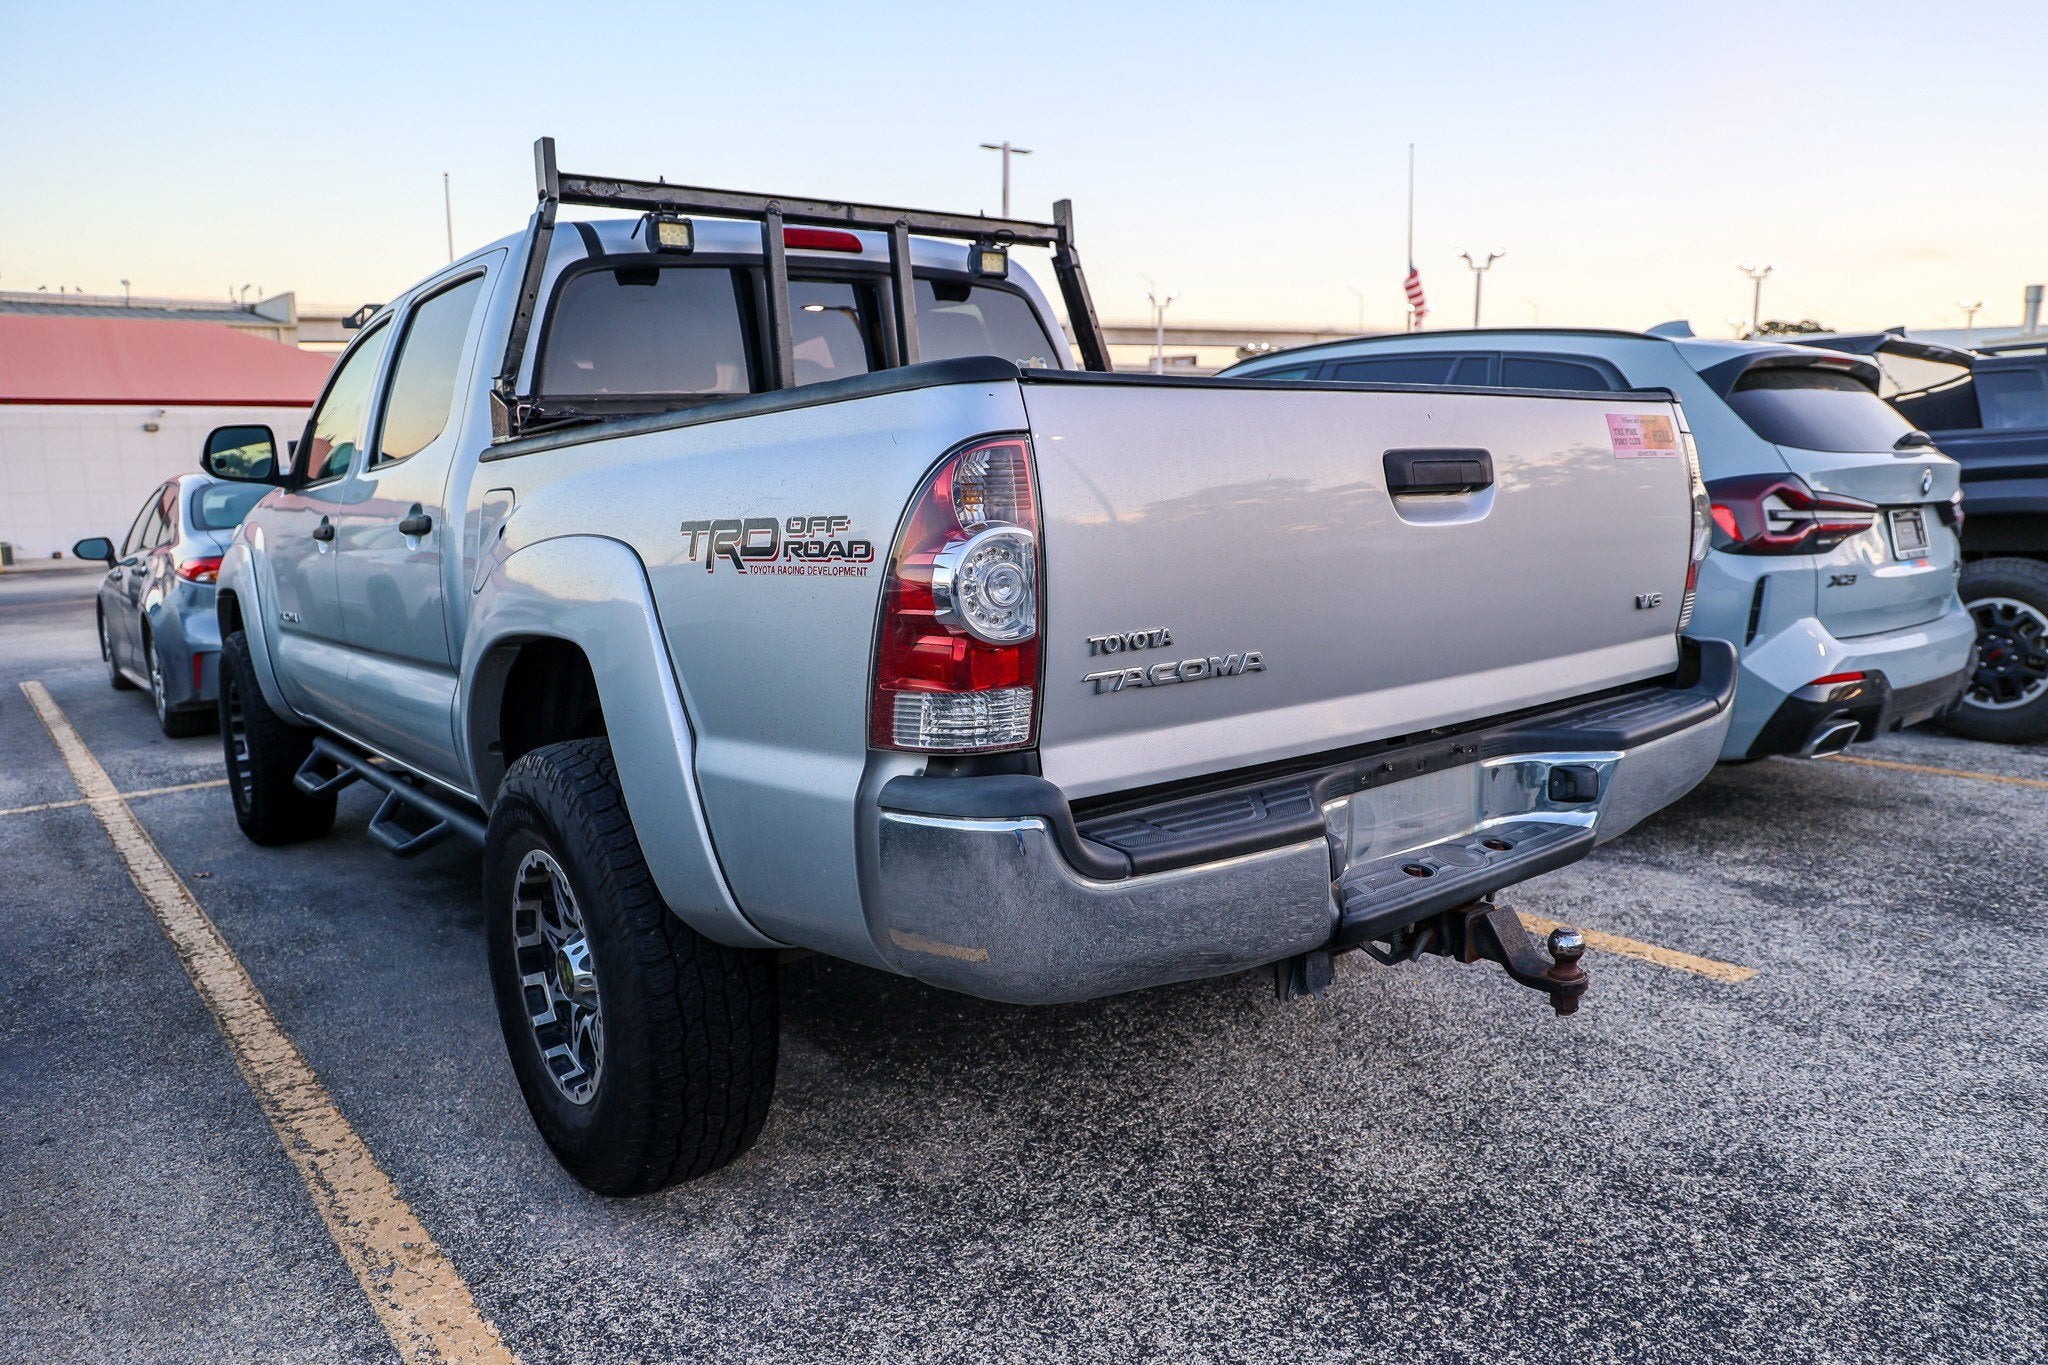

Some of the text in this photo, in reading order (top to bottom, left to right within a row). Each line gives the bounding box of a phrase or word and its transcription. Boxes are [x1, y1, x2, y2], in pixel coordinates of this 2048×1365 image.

[785, 515, 851, 538] OFF
[680, 517, 781, 574] TRD
[783, 540, 875, 563] ROAD
[750, 565, 868, 577] TOYOTA RACING DEVELOPMENT
[1827, 574, 1858, 588] X3
[1635, 592, 1663, 609] V6
[1087, 626, 1174, 656] TOYOTA
[1081, 651, 1268, 694] TACOMA
